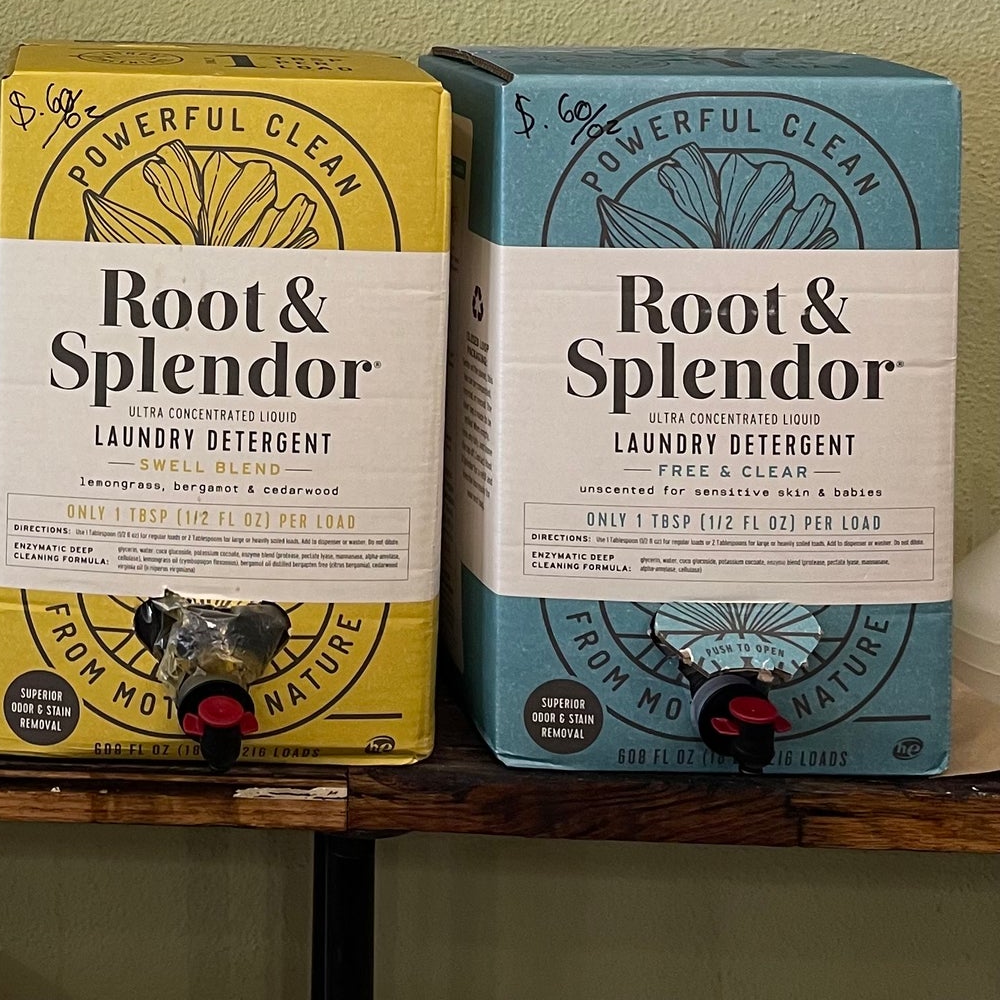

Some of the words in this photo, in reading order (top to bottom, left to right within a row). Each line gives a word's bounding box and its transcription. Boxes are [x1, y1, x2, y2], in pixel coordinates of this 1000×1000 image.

[68, 106, 245, 187] POWERFUL
[267, 113, 361, 196] CLEAN
[581, 109, 760, 192] POWERFUL
[783, 114, 880, 196] CLEAN
[100, 269, 265, 332] Root
[280, 275, 329, 333] &
[617, 275, 786, 335] Root
[801, 276, 851, 335] &
[129, 405, 164, 418] ULTRA
[169, 407, 255, 422] CONCENTRATED
[260, 409, 297, 423] LIQUID
[649, 413, 684, 424] ULTRA
[690, 413, 778, 425] CONCENTRATED
[783, 413, 820, 426] LIQUID
[95, 424, 194, 450] LAUNDRY
[207, 429, 332, 454] DETERGENT
[615, 432, 716, 455] LAUNDRY
[730, 434, 855, 456] DETERGENT
[140, 458, 204, 473] SWELL
[216, 461, 280, 475] BLEND
[659, 465, 709, 477] FREE
[720, 465, 730, 478] &
[742, 466, 808, 478] CLEAR
[80, 477, 165, 493] lemongrass,
[174, 483, 238, 495] bergamot
[248, 484, 255, 494] &
[264, 485, 339, 496] cedarwood
[580, 484, 655, 495] unscented
[663, 485, 686, 496] for
[694, 487, 769, 497] sensitive
[778, 487, 810, 498] skin
[818, 488, 825, 497] &
[834, 487, 882, 498] babies
[706, 644, 734, 658] PUSH
[736, 644, 750, 653] TO
[755, 644, 785, 658] OPEN
